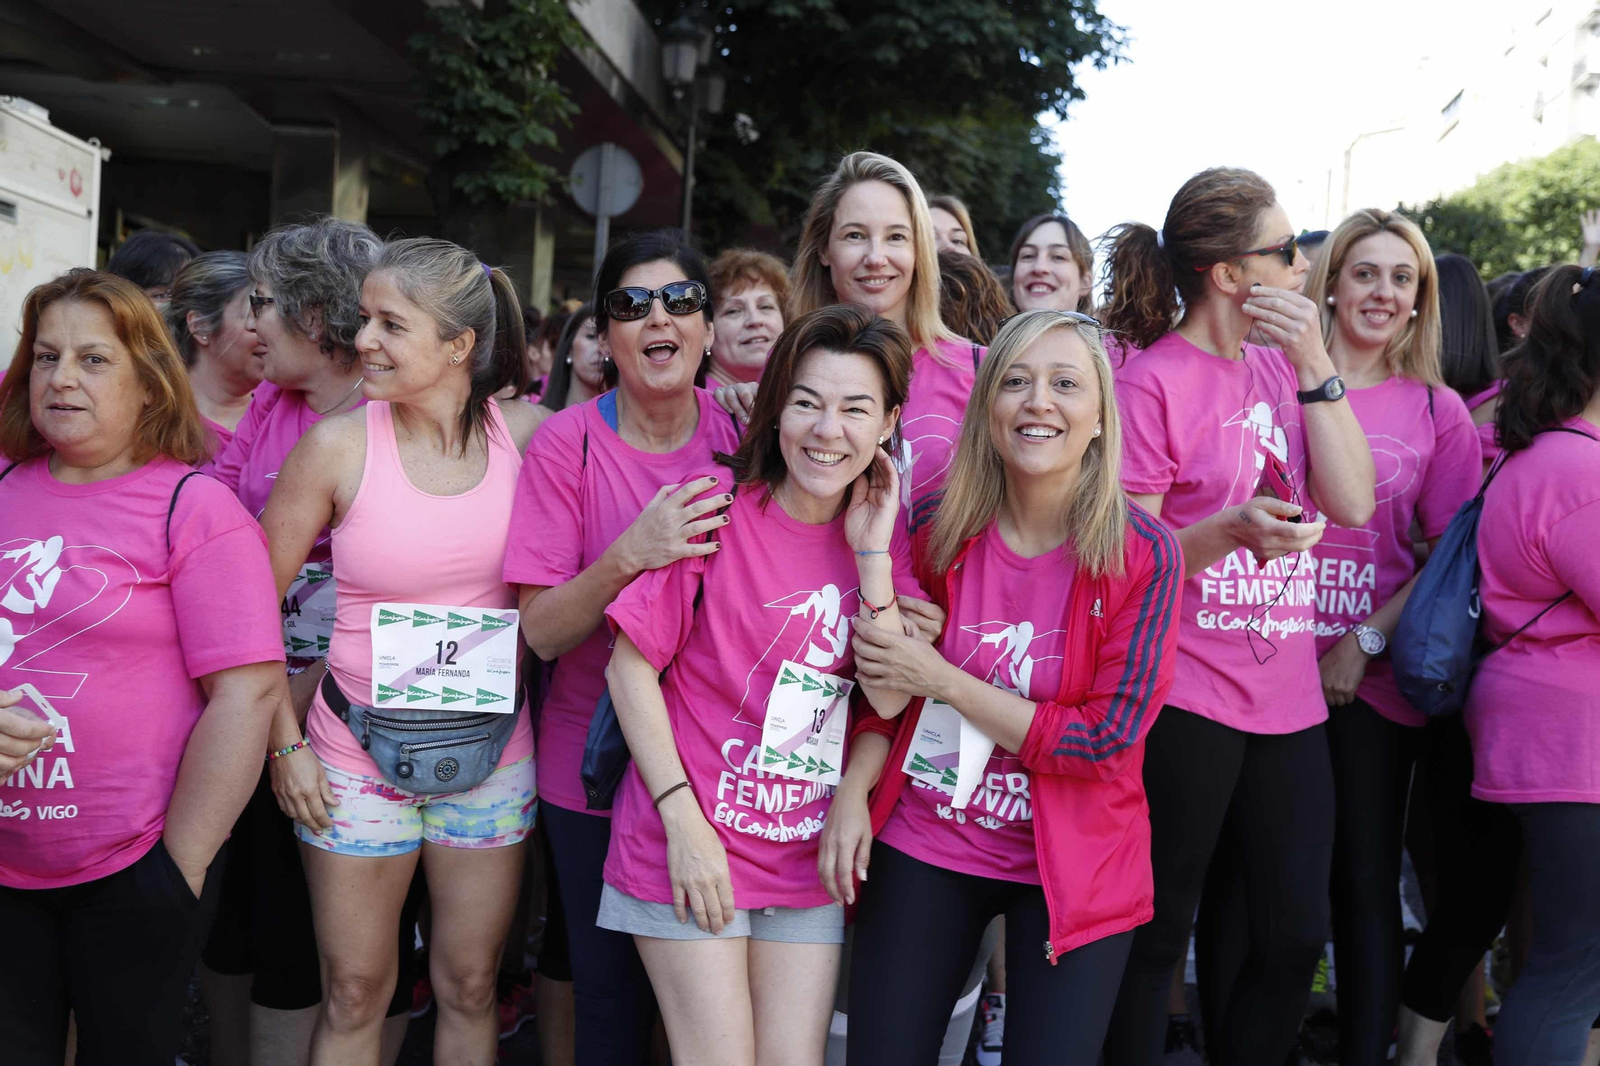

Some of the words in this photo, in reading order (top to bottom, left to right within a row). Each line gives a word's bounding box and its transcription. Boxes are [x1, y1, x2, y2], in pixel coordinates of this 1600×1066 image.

[436, 640, 459, 666] 12
[415, 666, 436, 676] MARÍA
[438, 668, 470, 678] FERNANDA
[811, 707, 826, 734] 13
[36, 804, 79, 820] VIGO
